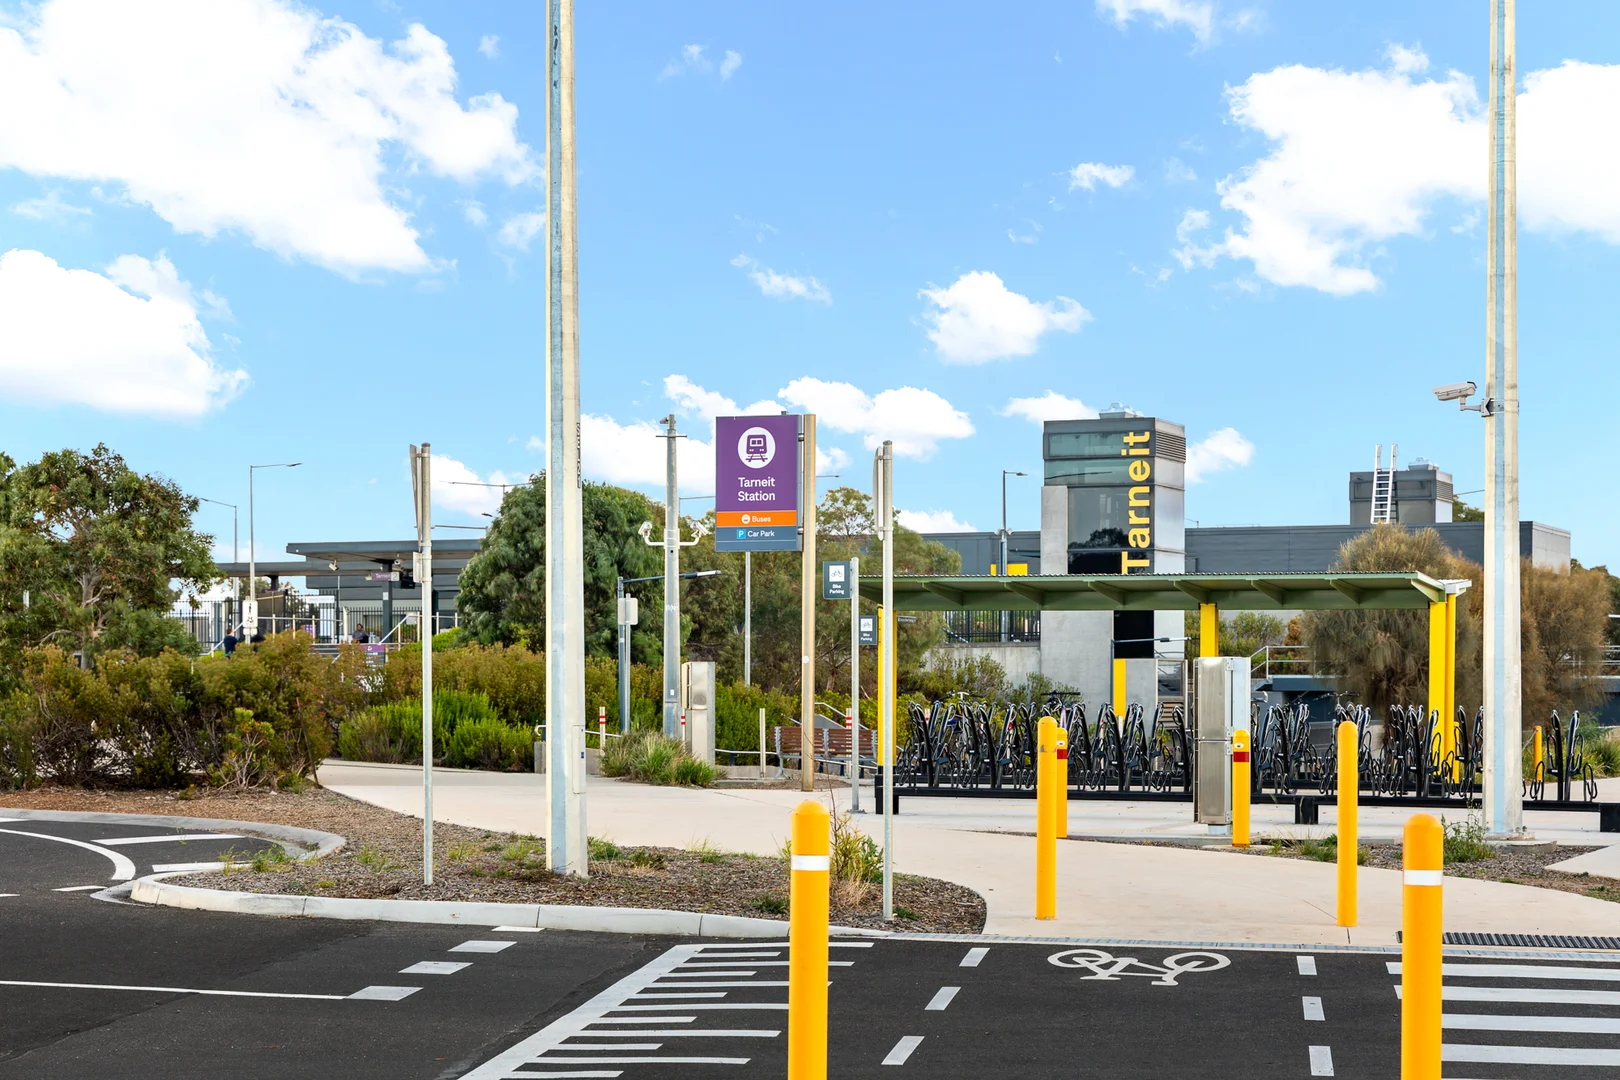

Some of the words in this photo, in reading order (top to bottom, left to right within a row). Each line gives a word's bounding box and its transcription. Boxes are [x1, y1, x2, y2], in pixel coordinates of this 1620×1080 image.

[737, 476, 776, 488] Tarneit
[737, 490, 776, 502] Station
[1121, 431, 1151, 575] Tarneit
[751, 515, 772, 523] Buses
[392, 572, 398, 580] 2
